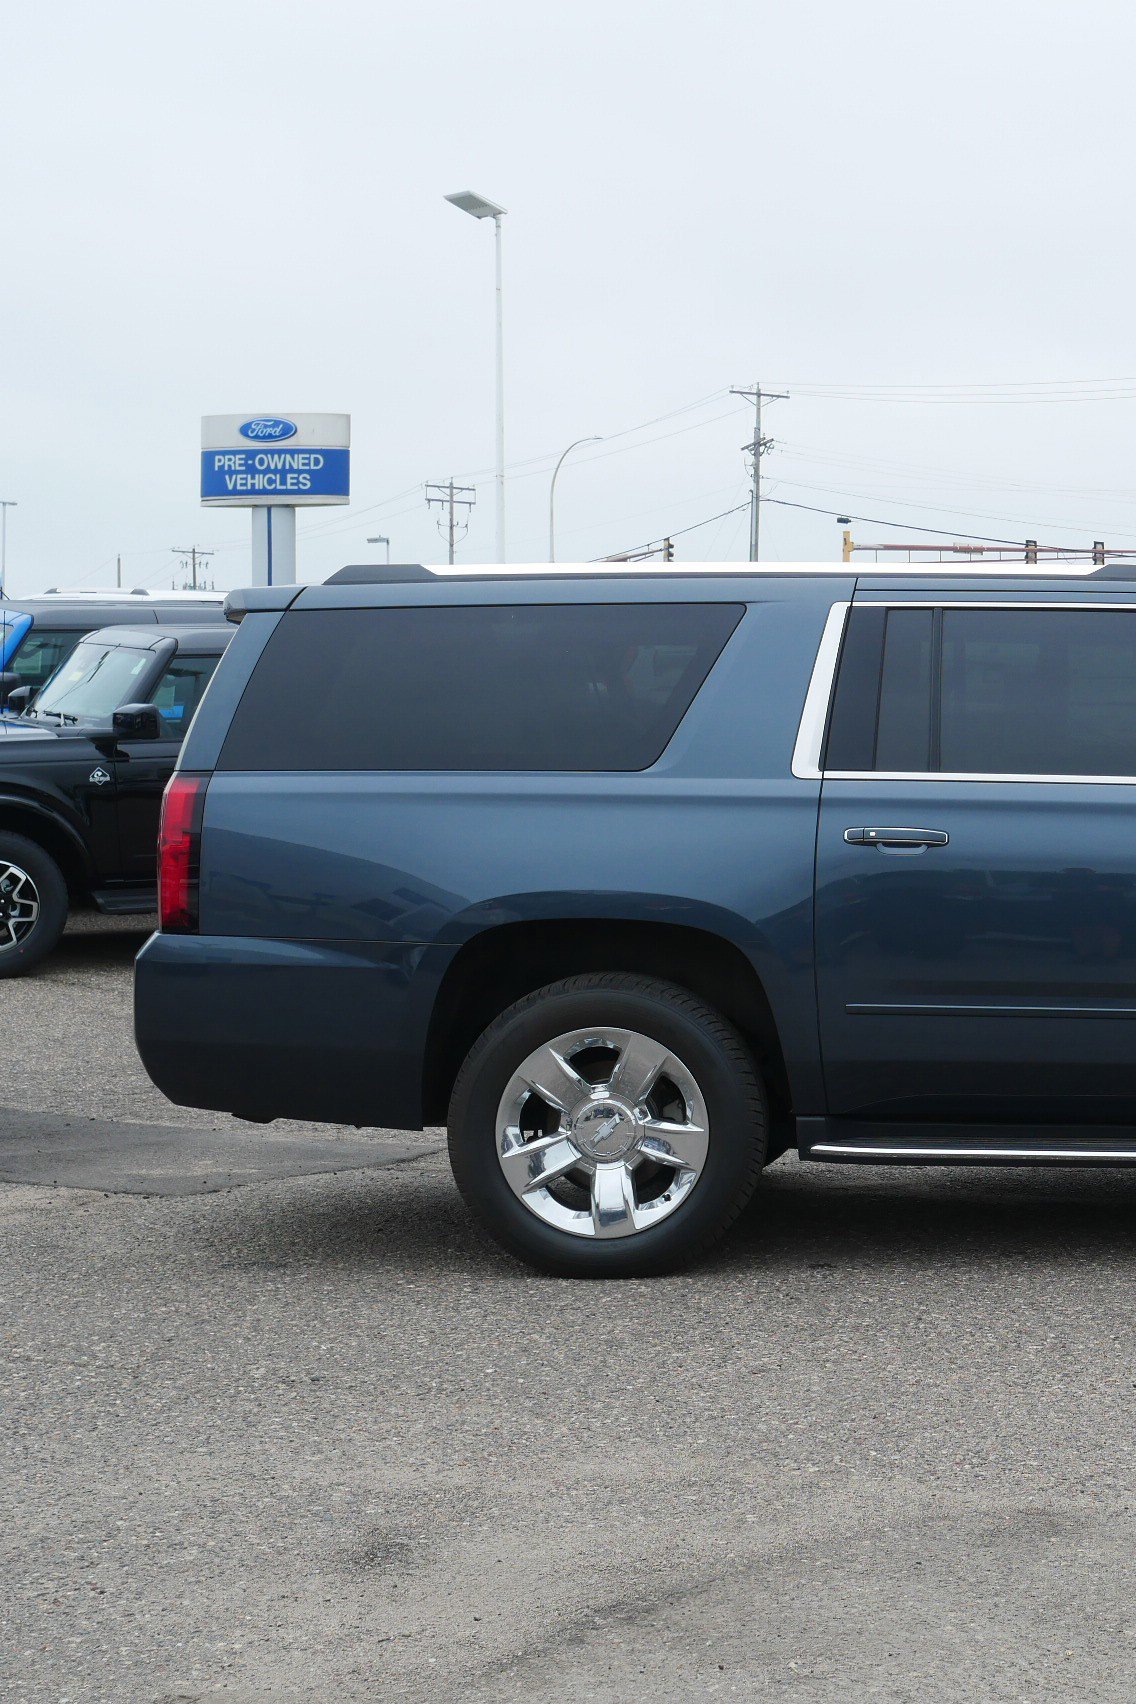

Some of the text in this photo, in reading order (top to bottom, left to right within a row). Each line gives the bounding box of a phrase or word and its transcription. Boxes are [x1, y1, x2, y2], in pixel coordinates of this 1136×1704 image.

[248, 419, 283, 437] Ford
[214, 453, 324, 471] PRE-OWNED
[225, 473, 311, 490] VEHICLES
